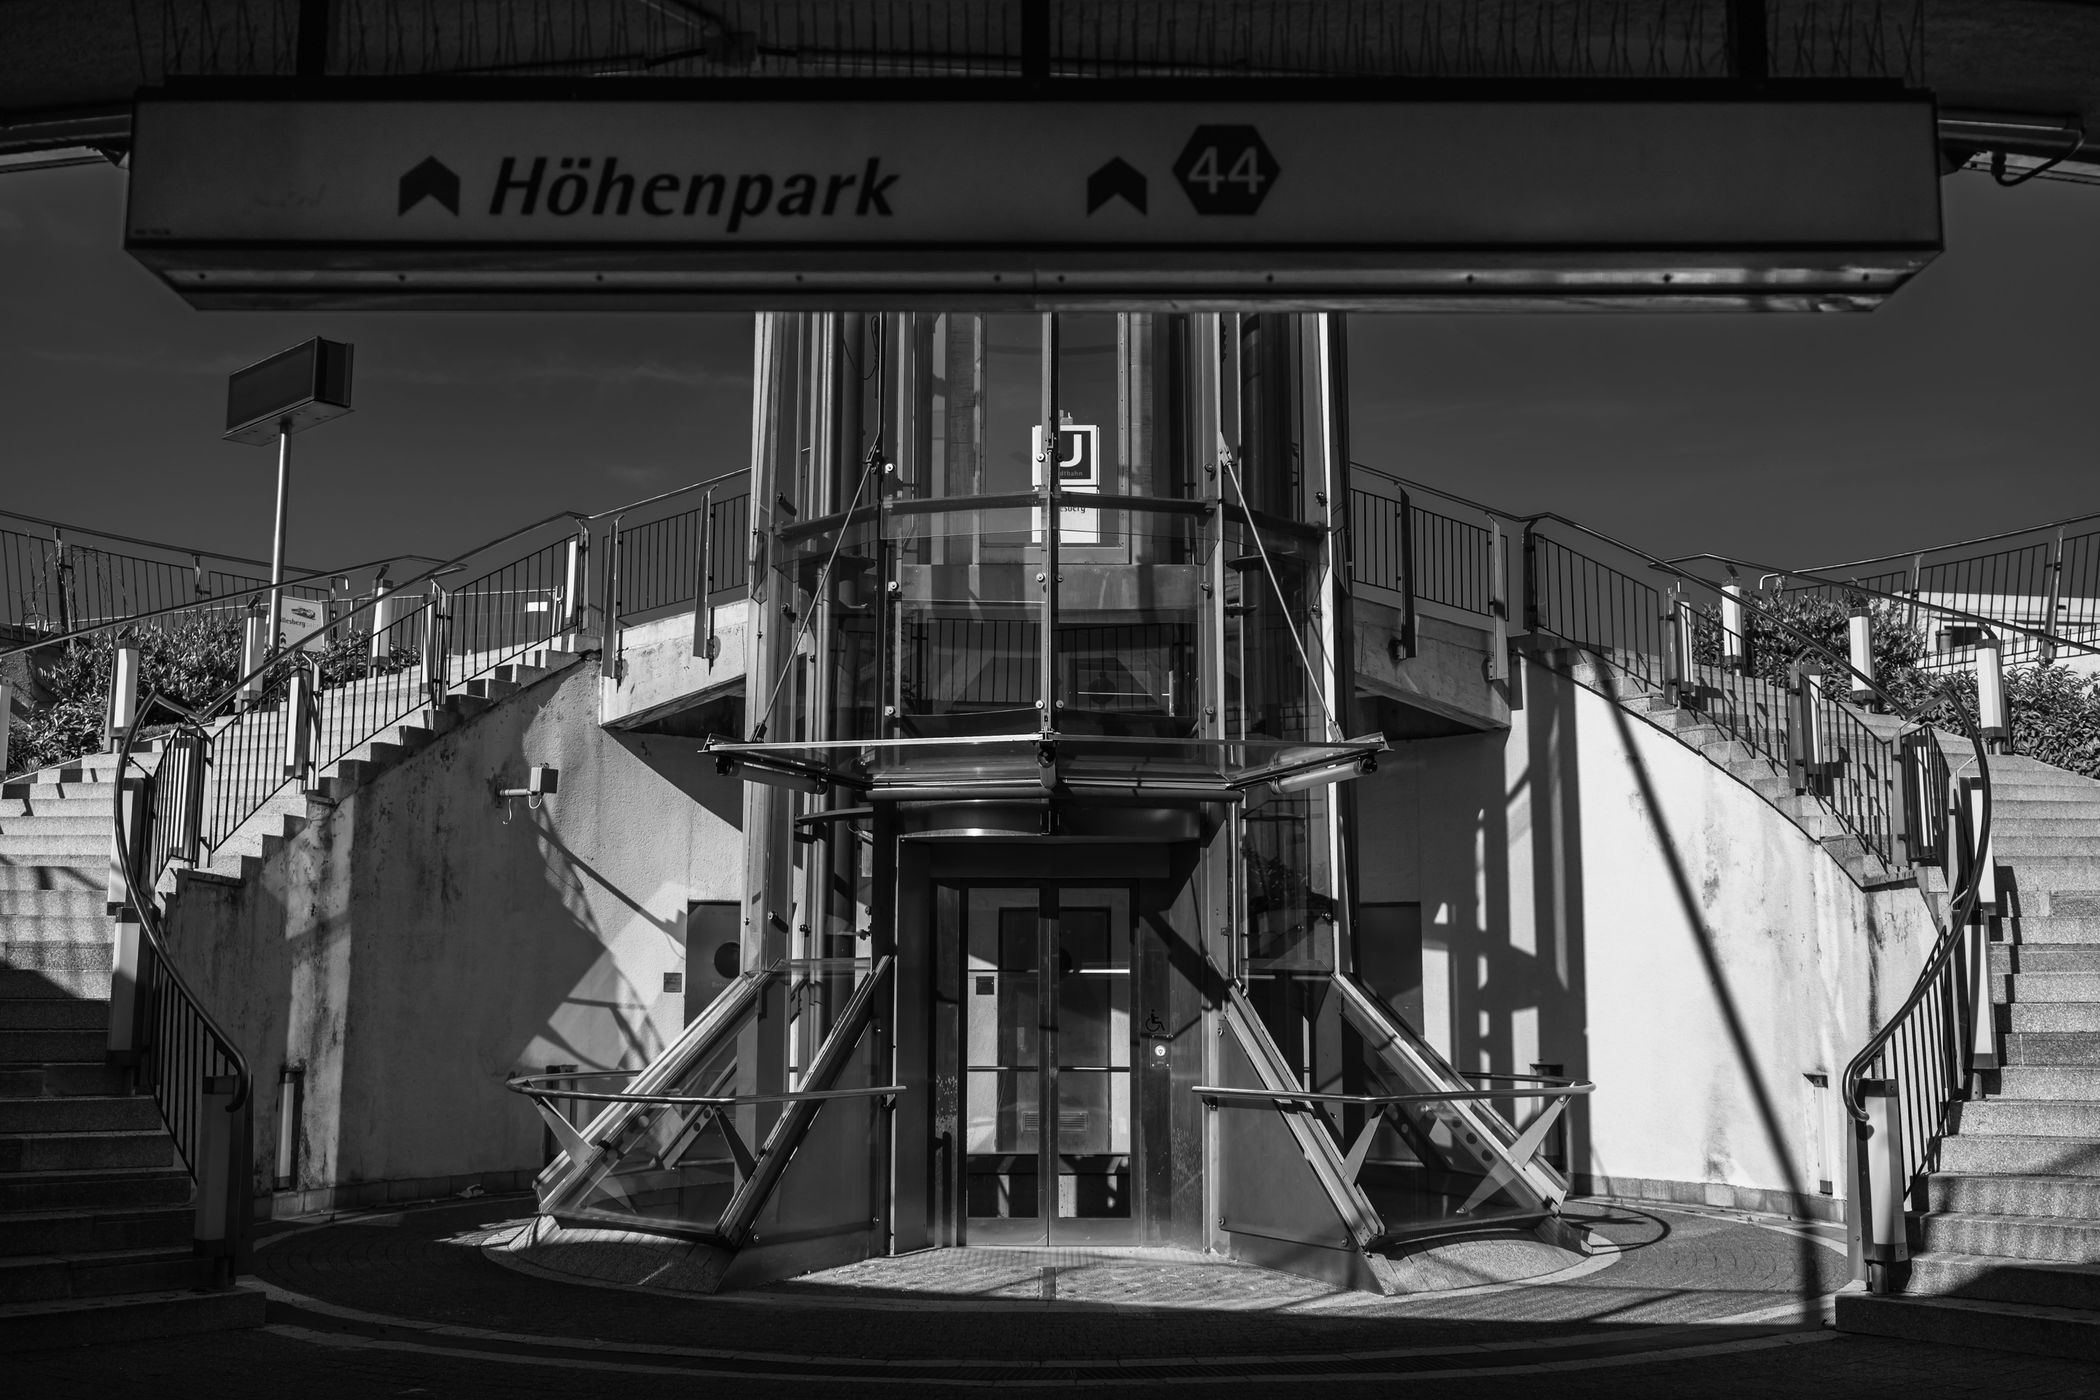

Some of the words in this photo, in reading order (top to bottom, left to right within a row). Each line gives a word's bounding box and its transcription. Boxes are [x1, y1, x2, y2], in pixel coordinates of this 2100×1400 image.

[489, 157, 899, 233] Höhenpark
[1188, 144, 1265, 195] 44
[1059, 469, 1083, 477] dtbahn
